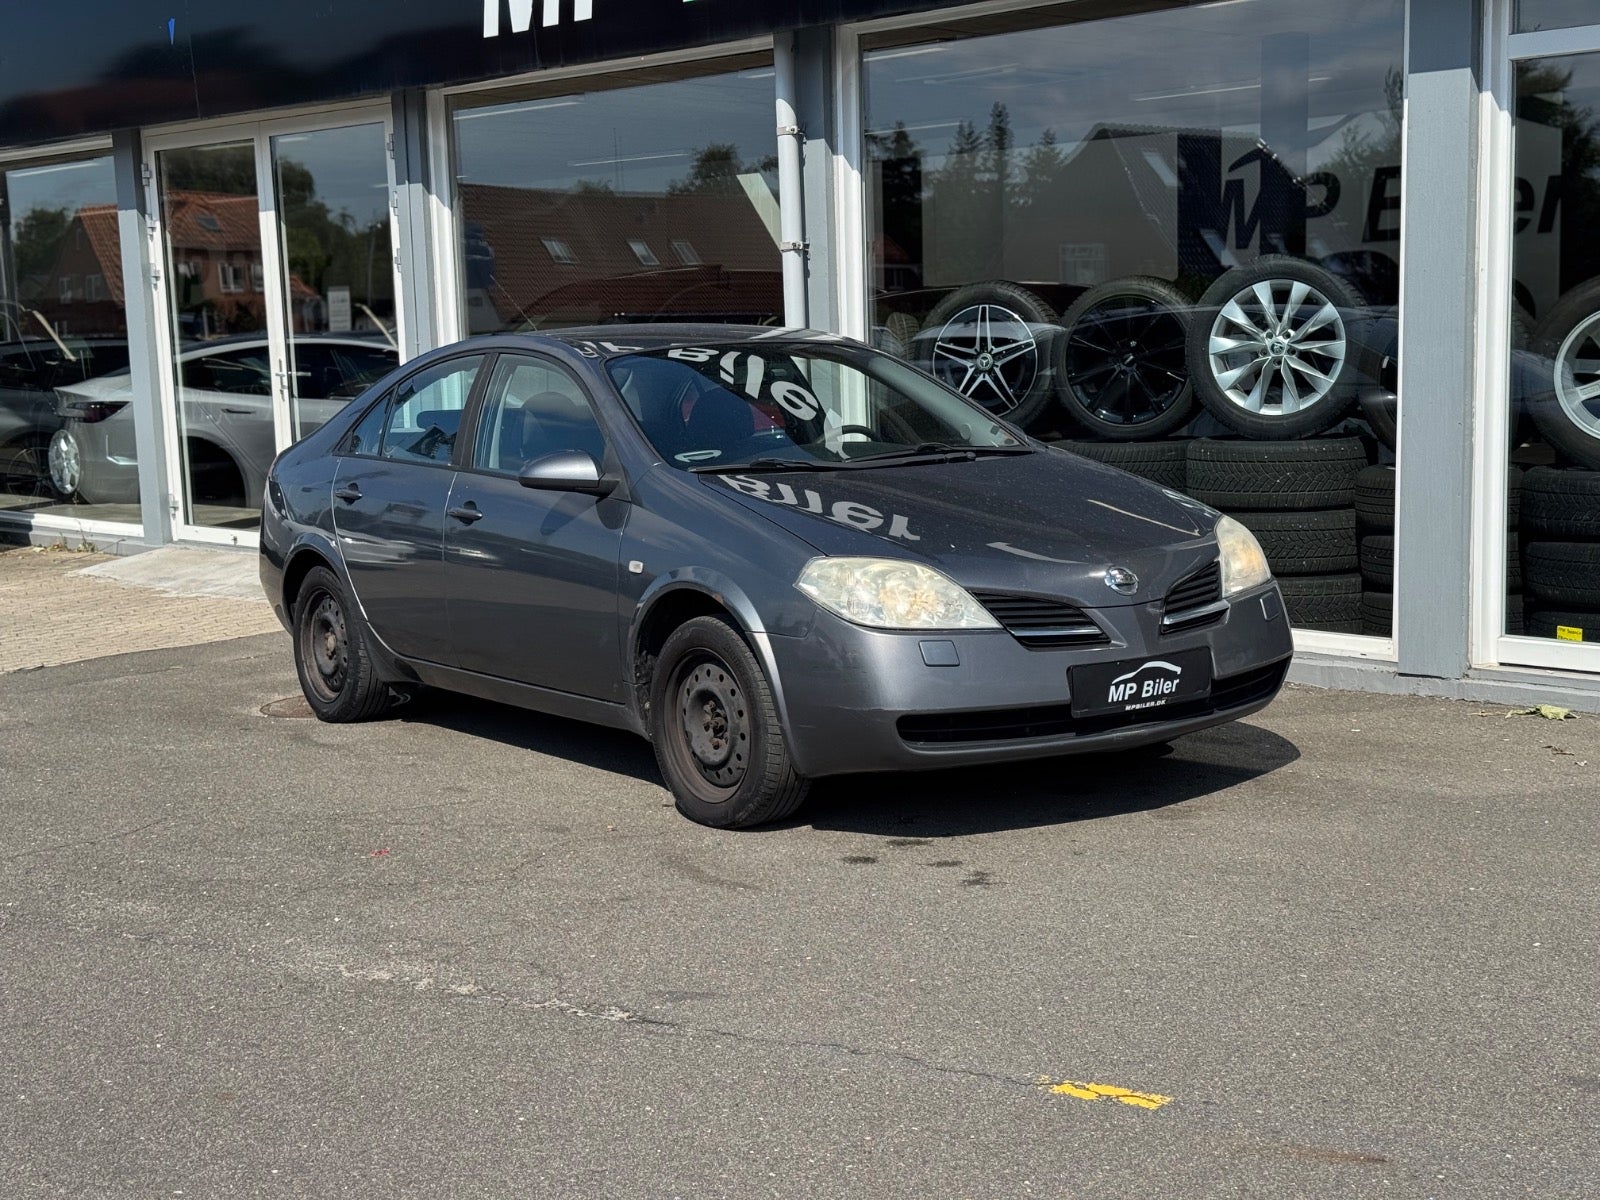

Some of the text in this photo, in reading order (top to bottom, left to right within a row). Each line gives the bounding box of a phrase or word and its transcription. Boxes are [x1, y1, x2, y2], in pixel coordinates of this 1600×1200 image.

[1108, 677, 1180, 702] MP Biler
[1125, 699, 1166, 711] MPBILER.DK
